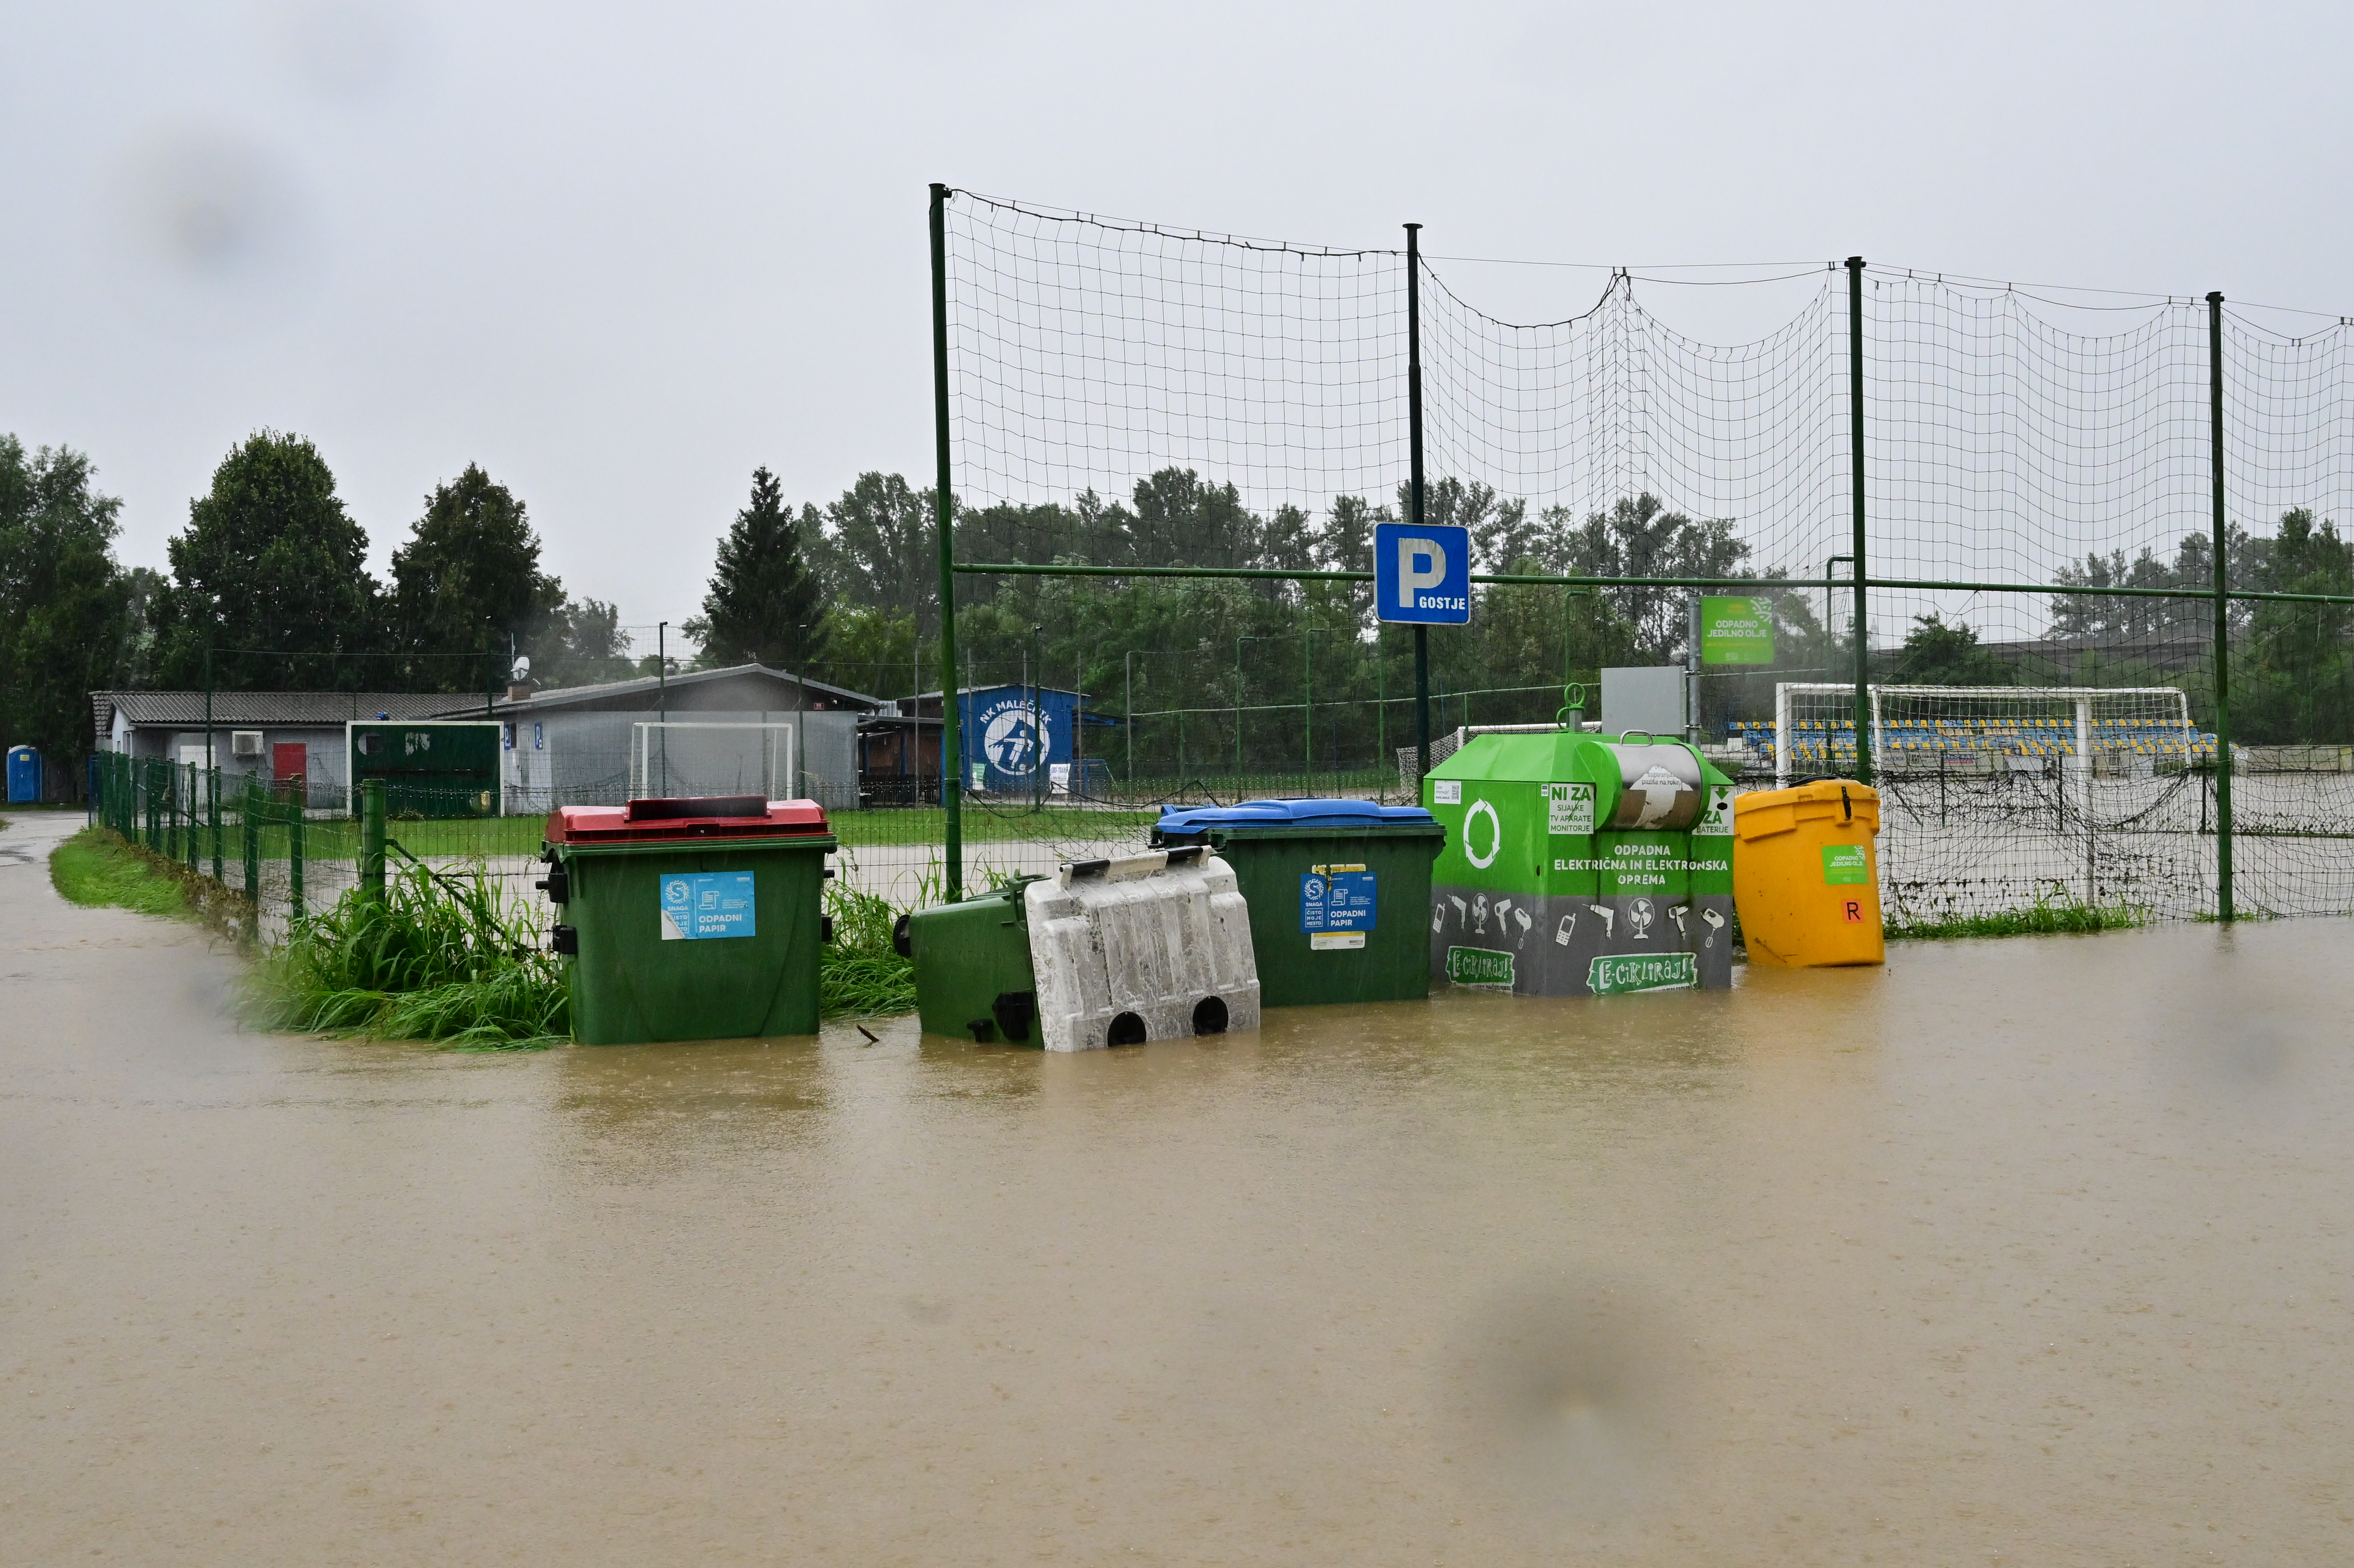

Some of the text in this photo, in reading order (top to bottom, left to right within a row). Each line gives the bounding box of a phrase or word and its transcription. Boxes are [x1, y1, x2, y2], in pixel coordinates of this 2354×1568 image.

[1398, 538, 1446, 608] P
[1419, 596, 1466, 610] GOSTJE
[1716, 620, 1758, 628] ODPADNO
[980, 707, 996, 724] NK
[1552, 787, 1567, 801] NI
[1571, 787, 1591, 801] ZA
[1703, 811, 1723, 824] ZA
[1614, 845, 1671, 856] ODPADNA
[1554, 857, 1728, 871] ELEKTRIČNA IN ELEKTRONSKA
[1618, 874, 1666, 885] OPREMA
[1846, 902, 1860, 920] R
[699, 914, 742, 923] ODPADNI
[699, 925, 726, 933] PAPIR
